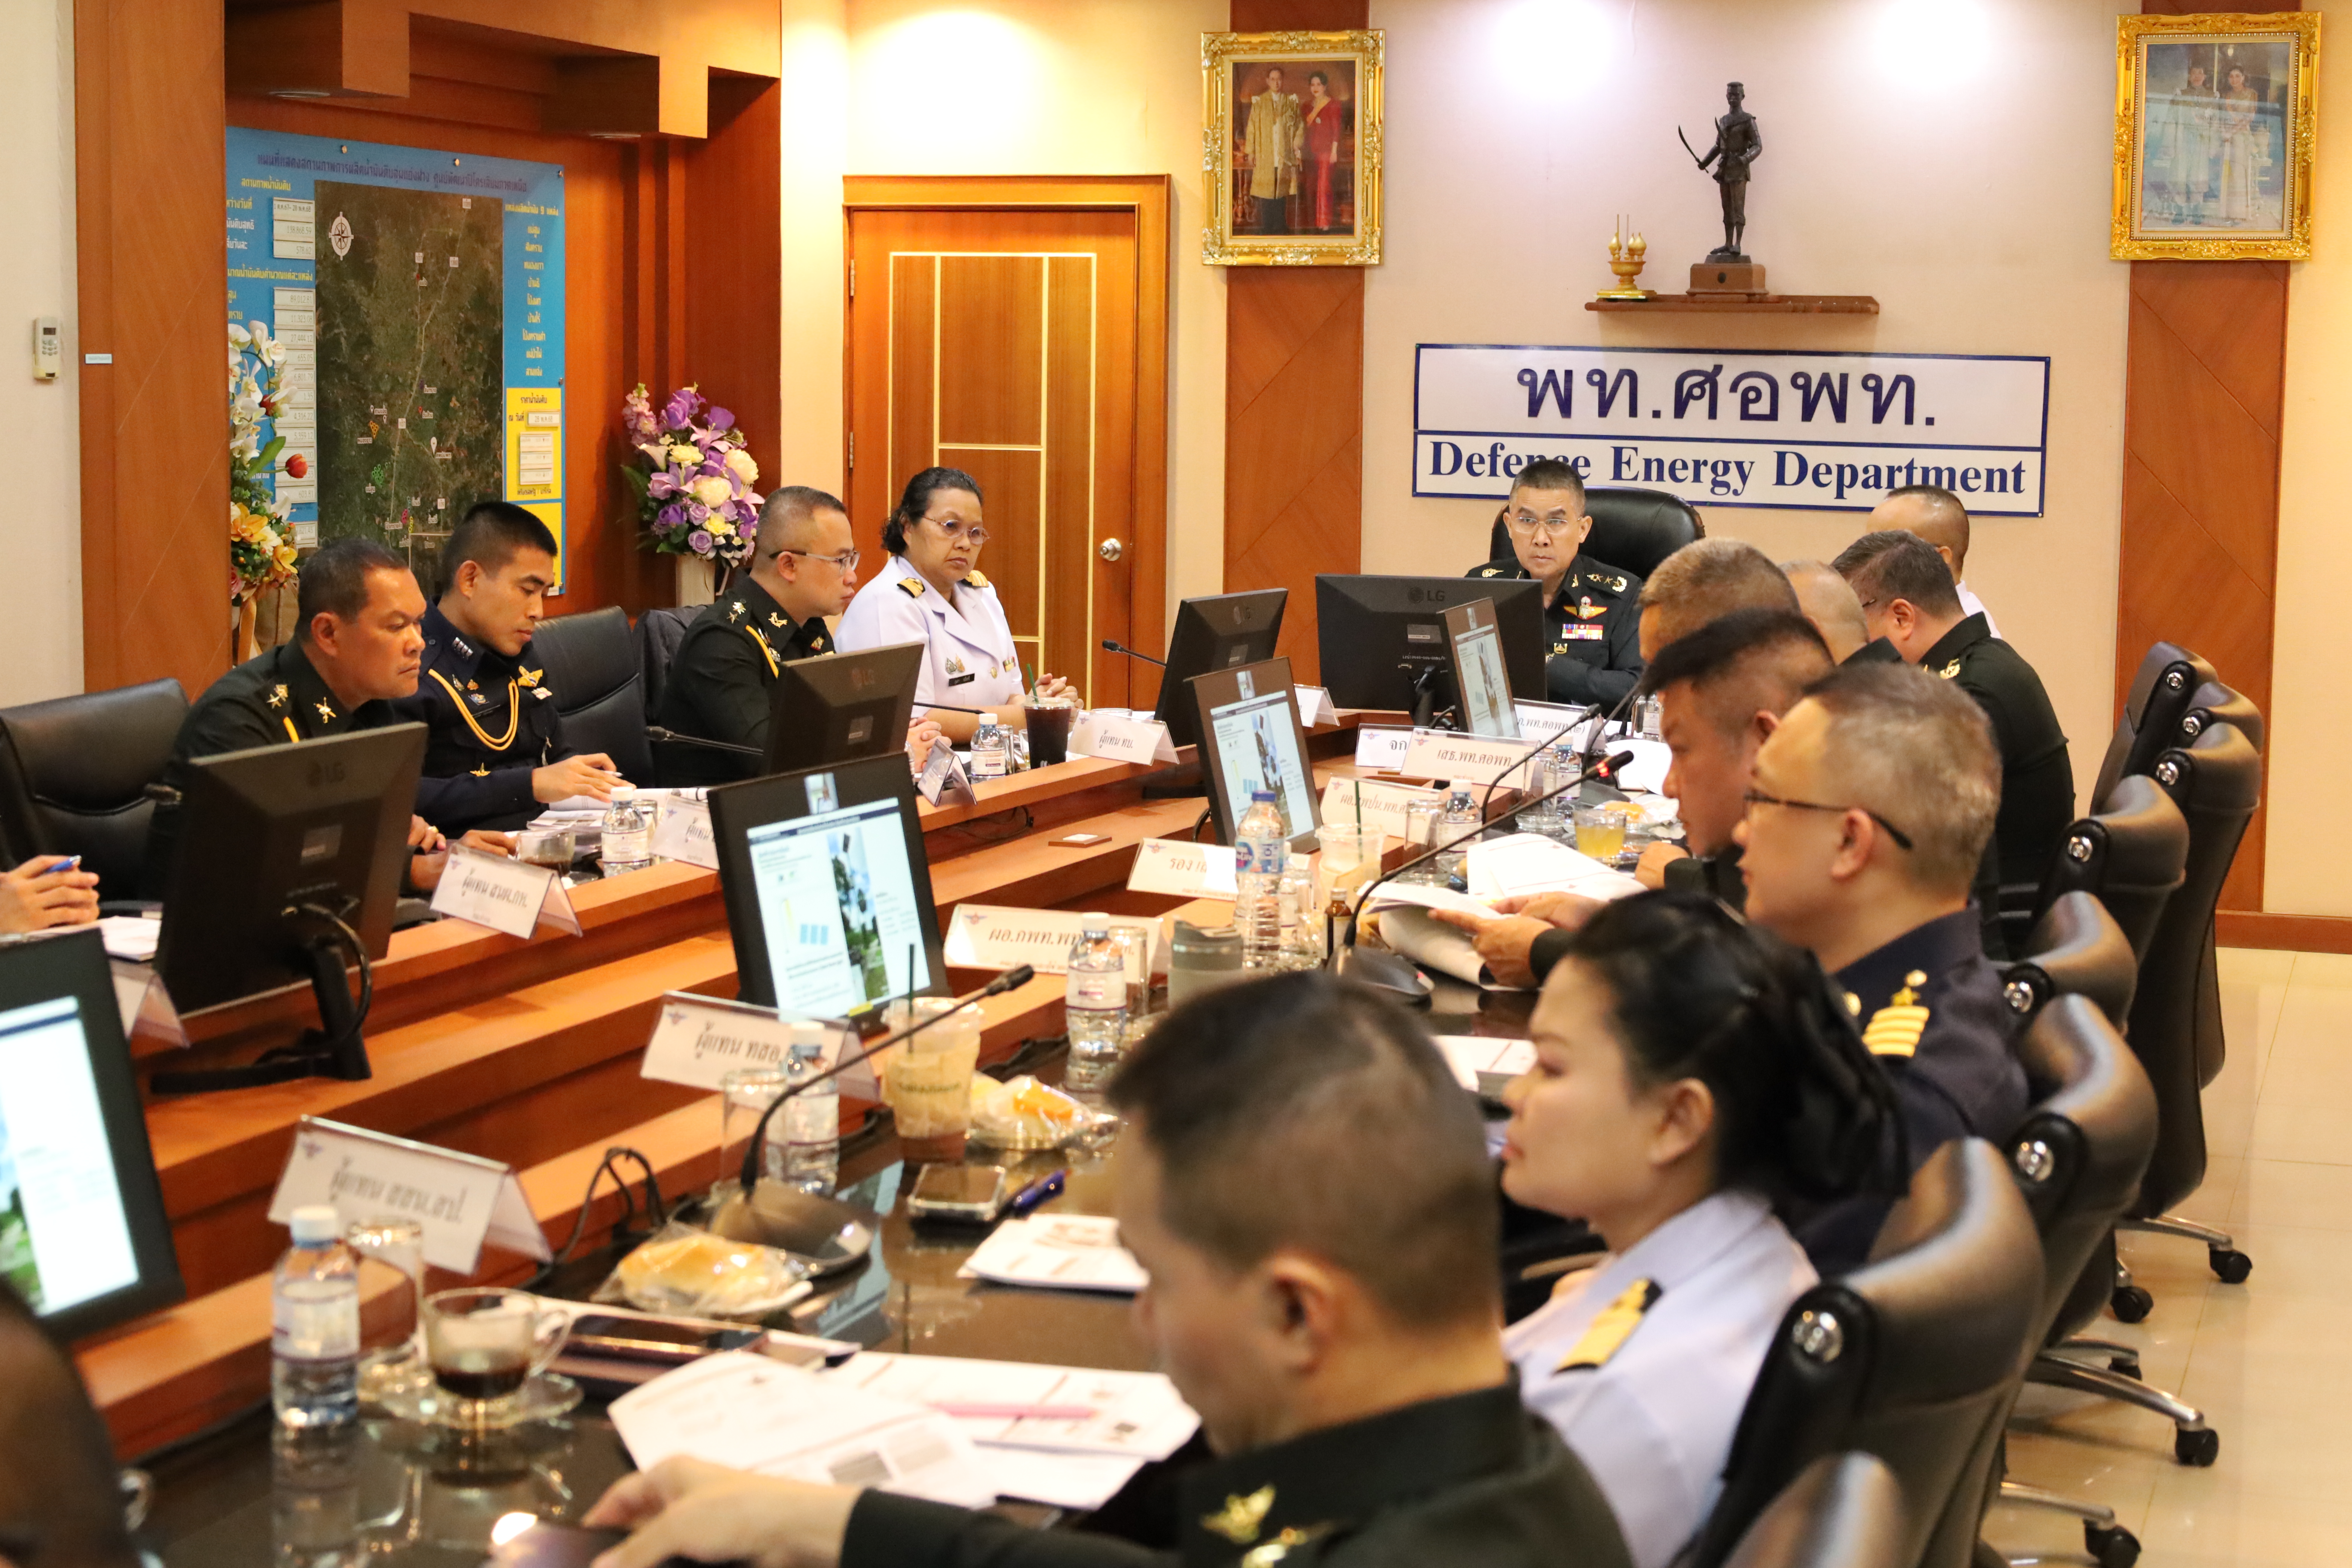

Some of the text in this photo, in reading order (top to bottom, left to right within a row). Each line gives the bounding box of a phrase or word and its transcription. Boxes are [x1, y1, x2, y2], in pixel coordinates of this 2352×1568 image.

[241, 176, 291, 191] สถานภาพน้ำมันดิบ
[541, 206, 544, 214] 9
[296, 246, 312, 255] 578.62
[298, 354, 313, 362] 655.05
[521, 393, 547, 404] ราคาน้ำมันดิบ
[1517, 363, 1936, 426] พท.ศอพท.
[516, 411, 524, 421] วันที่
[1429, 441, 2026, 500] Defee Energy Department
[1427, 590, 1445, 602] LG
[1099, 729, 1133, 749] ผู้แทน ทบ.
[1437, 749, 1514, 767] เสธ.พท.ศอพท.
[684, 816, 712, 843] ผู้แทน
[1169, 858, 1193, 873] รอง
[461, 868, 490, 897] ผู้แทน
[696, 1021, 743, 1059] ผู้แทน
[329, 1155, 387, 1205] ผู้แทน
